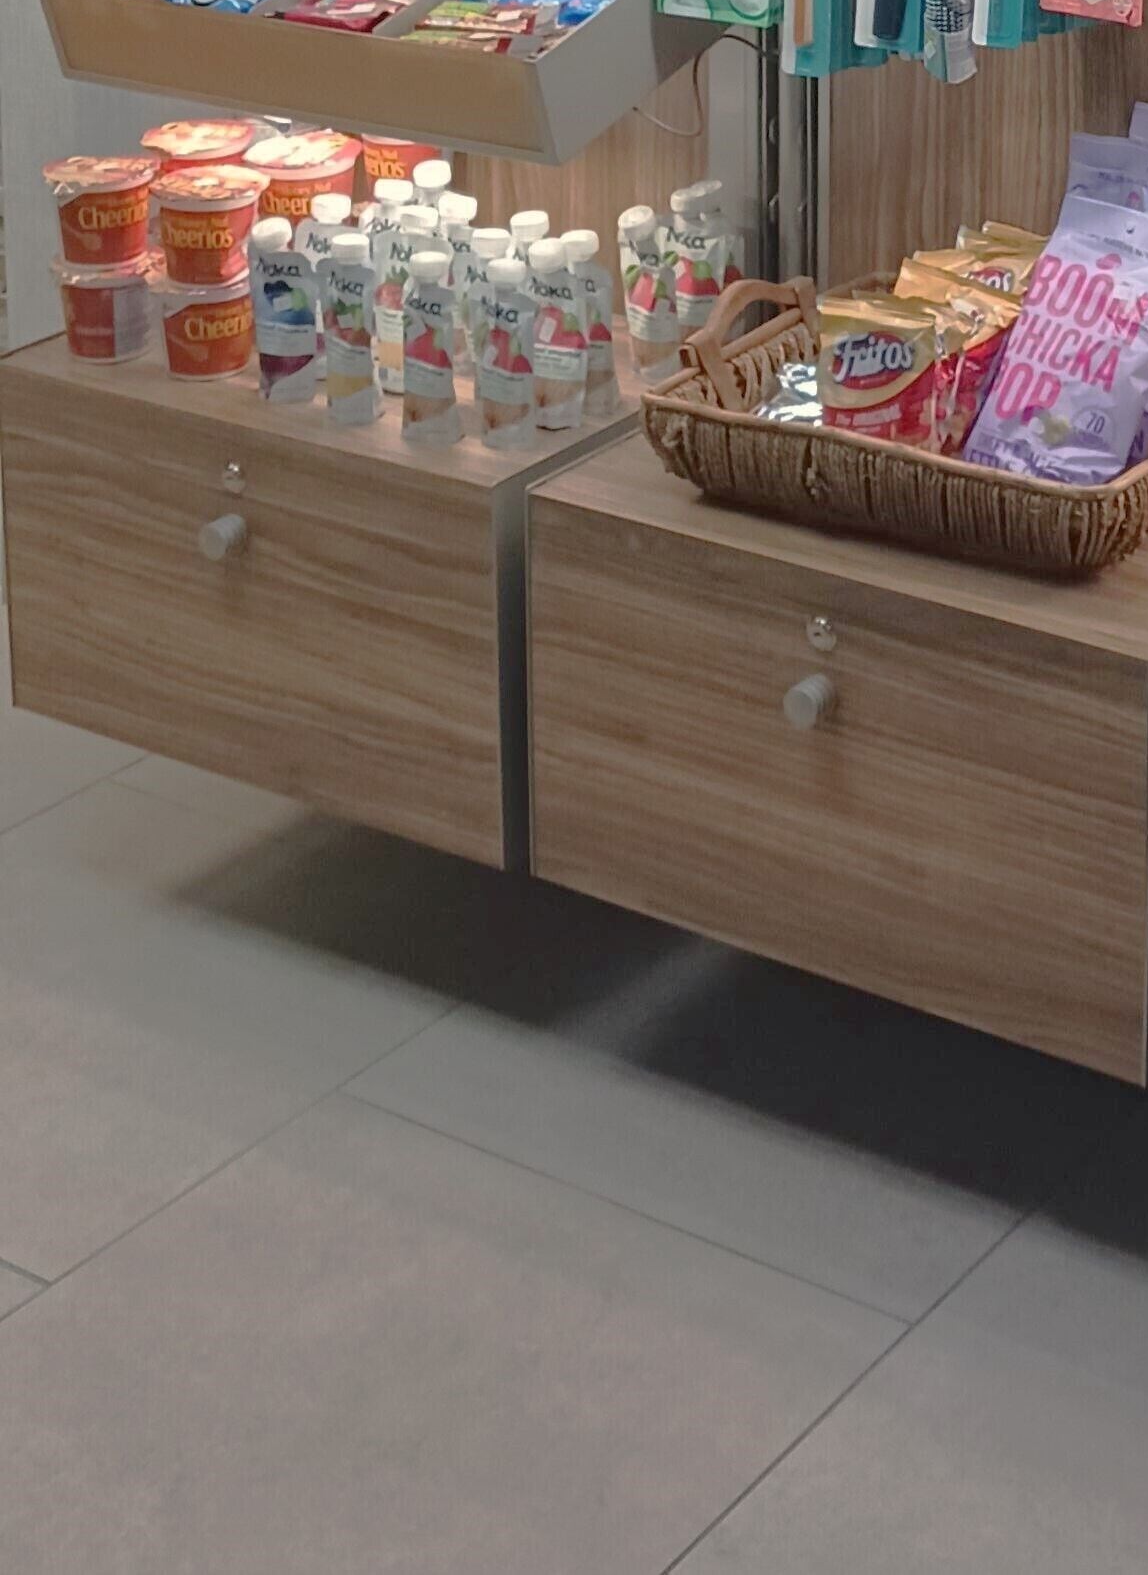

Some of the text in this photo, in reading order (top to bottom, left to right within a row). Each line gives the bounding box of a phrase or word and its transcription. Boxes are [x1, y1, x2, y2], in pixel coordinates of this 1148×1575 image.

[163, 224, 234, 252] Cheerios
[256, 256, 302, 279] Noka
[329, 271, 364, 296] Noka
[530, 276, 574, 301] Noka
[832, 330, 913, 385] Fritos
[1086, 412, 1106, 433] 70
